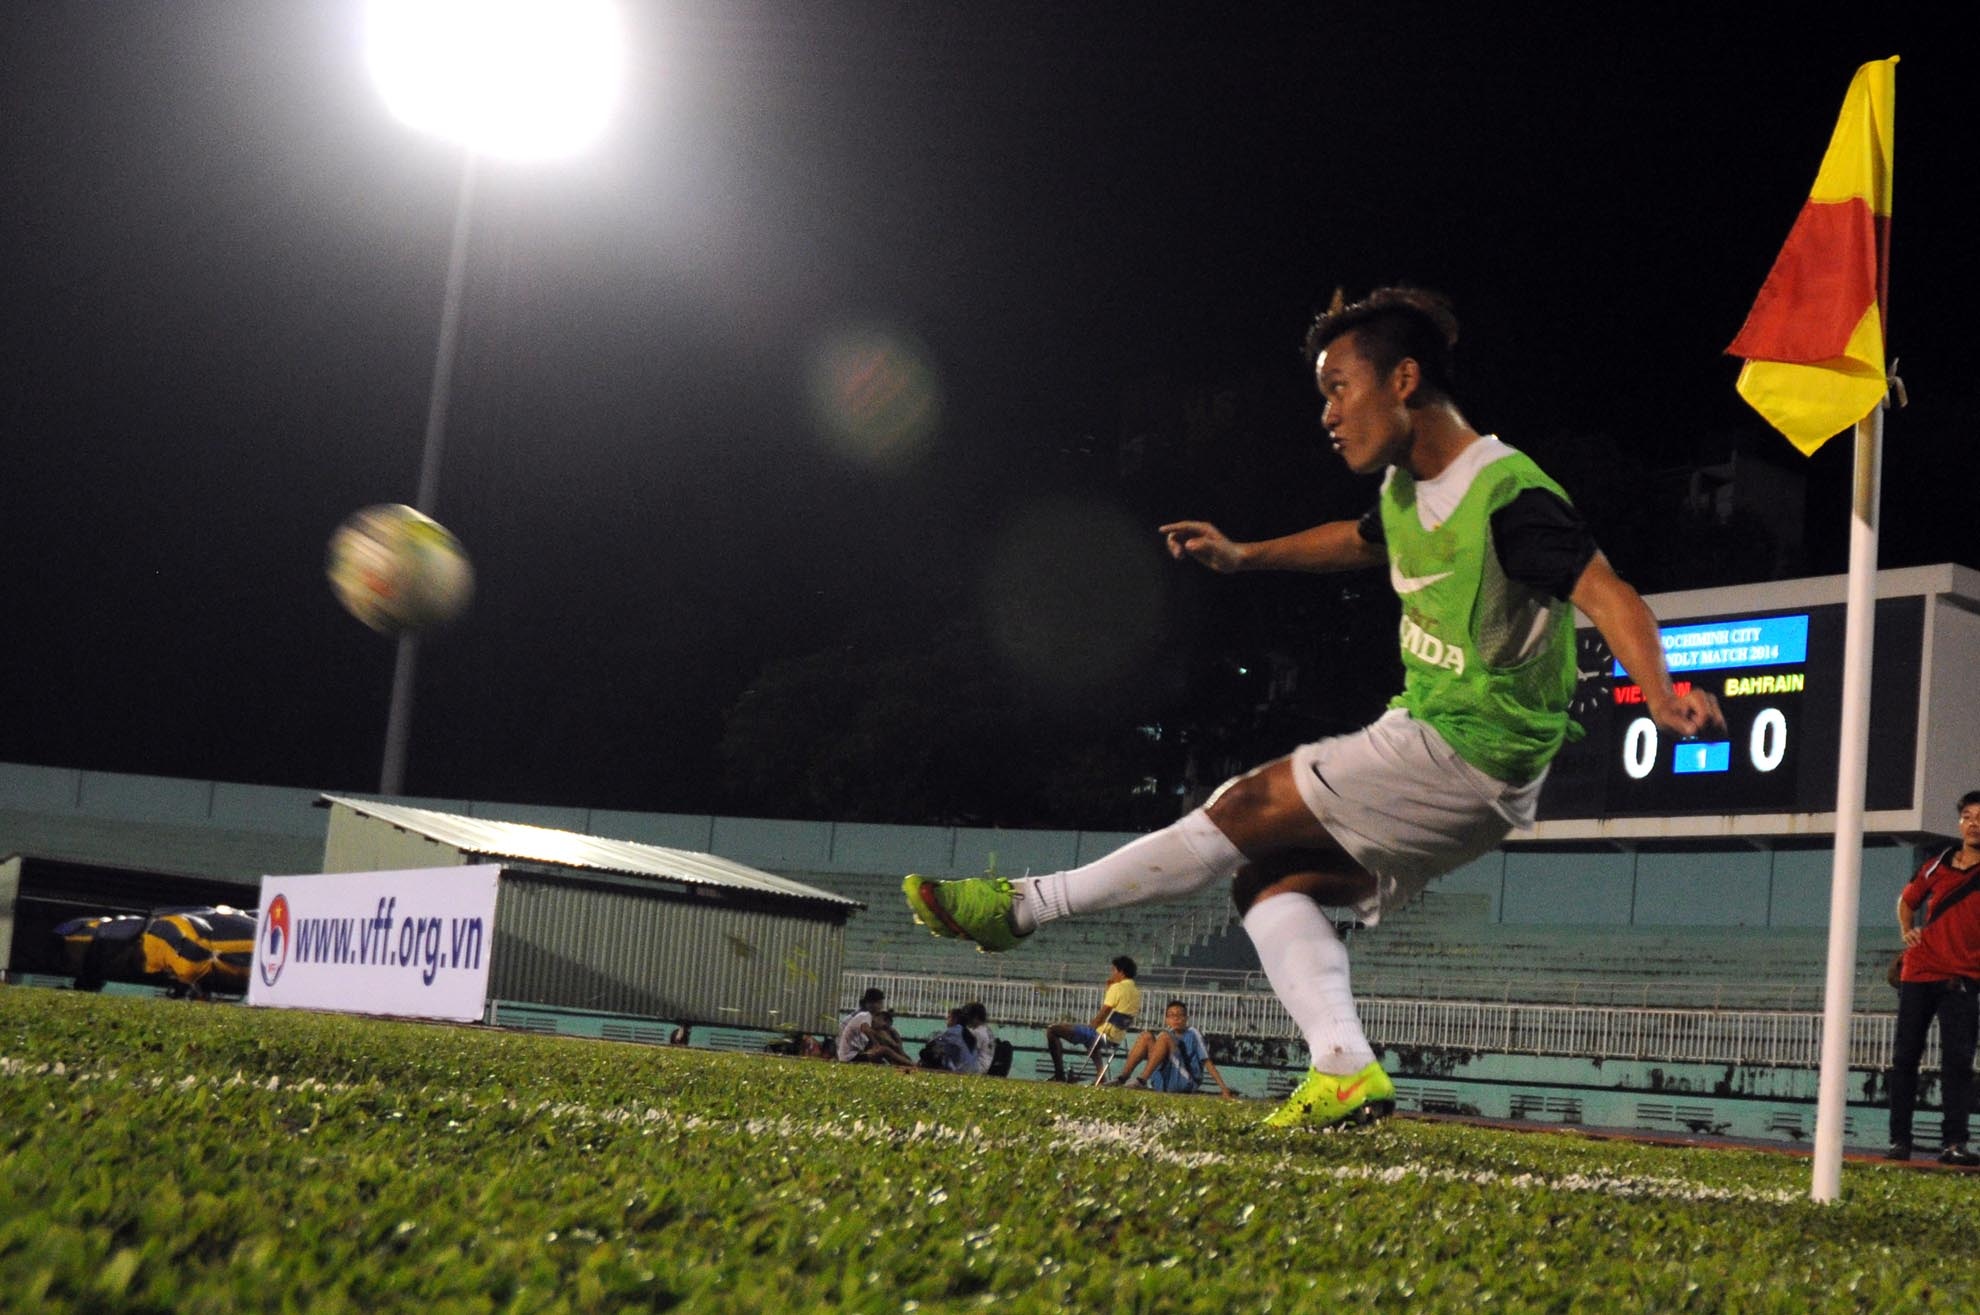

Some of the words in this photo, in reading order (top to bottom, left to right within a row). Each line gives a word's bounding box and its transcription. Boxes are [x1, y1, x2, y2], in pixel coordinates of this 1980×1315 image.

[1399, 614, 1465, 677] NDA
[1664, 650, 1699, 667] NDLY
[1701, 647, 1748, 665] MATCH
[1749, 644, 1779, 661] 2014
[1732, 627, 1762, 643] CITY
[1724, 673, 1805, 698] BAHRAIN
[1623, 716, 1658, 780] 0
[1696, 748, 1707, 769] 1
[1750, 707, 1787, 773] 0
[295, 896, 484, 987] www.vff.org.vn
